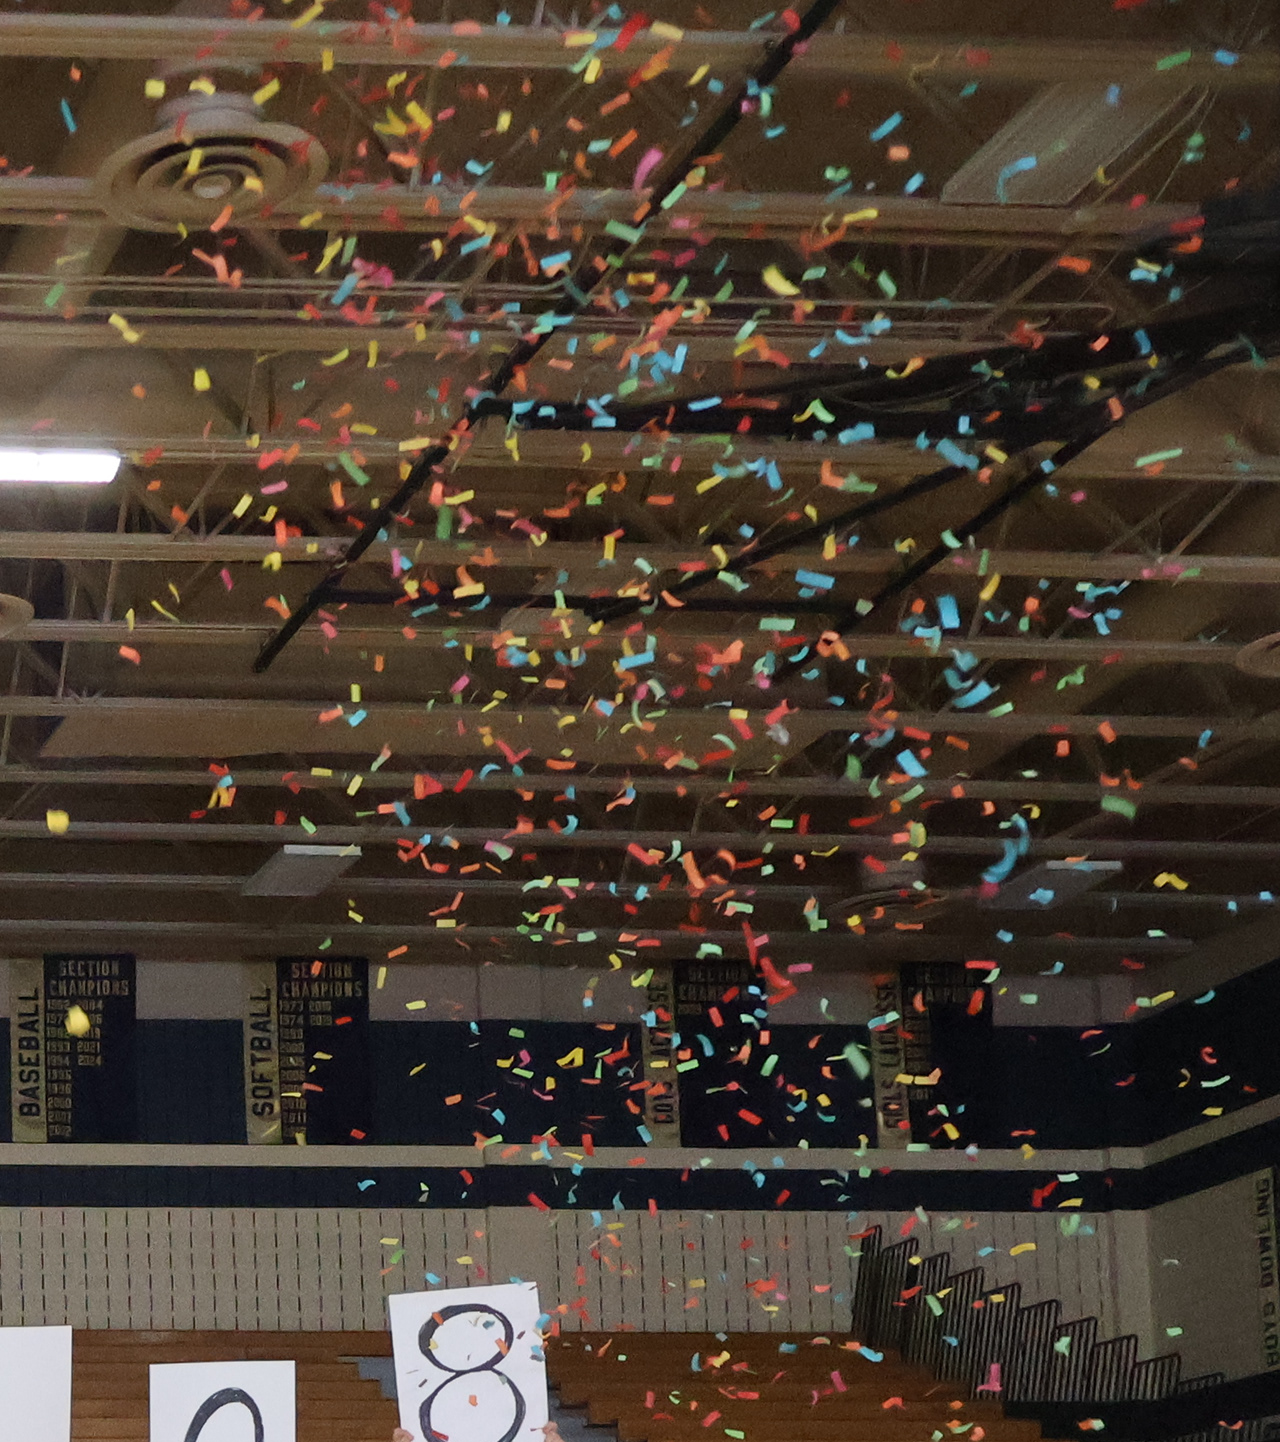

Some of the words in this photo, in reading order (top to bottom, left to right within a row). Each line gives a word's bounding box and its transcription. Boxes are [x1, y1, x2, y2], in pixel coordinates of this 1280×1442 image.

[49, 979, 130, 997] CHAMPIONS
[59, 960, 120, 977] SECTION
[282, 981, 363, 998] CHAMPIONS
[18, 987, 41, 1117] BASEBALL
[249, 987, 274, 1117] SOFTBALL
[1255, 1178, 1274, 1289] BOWLING
